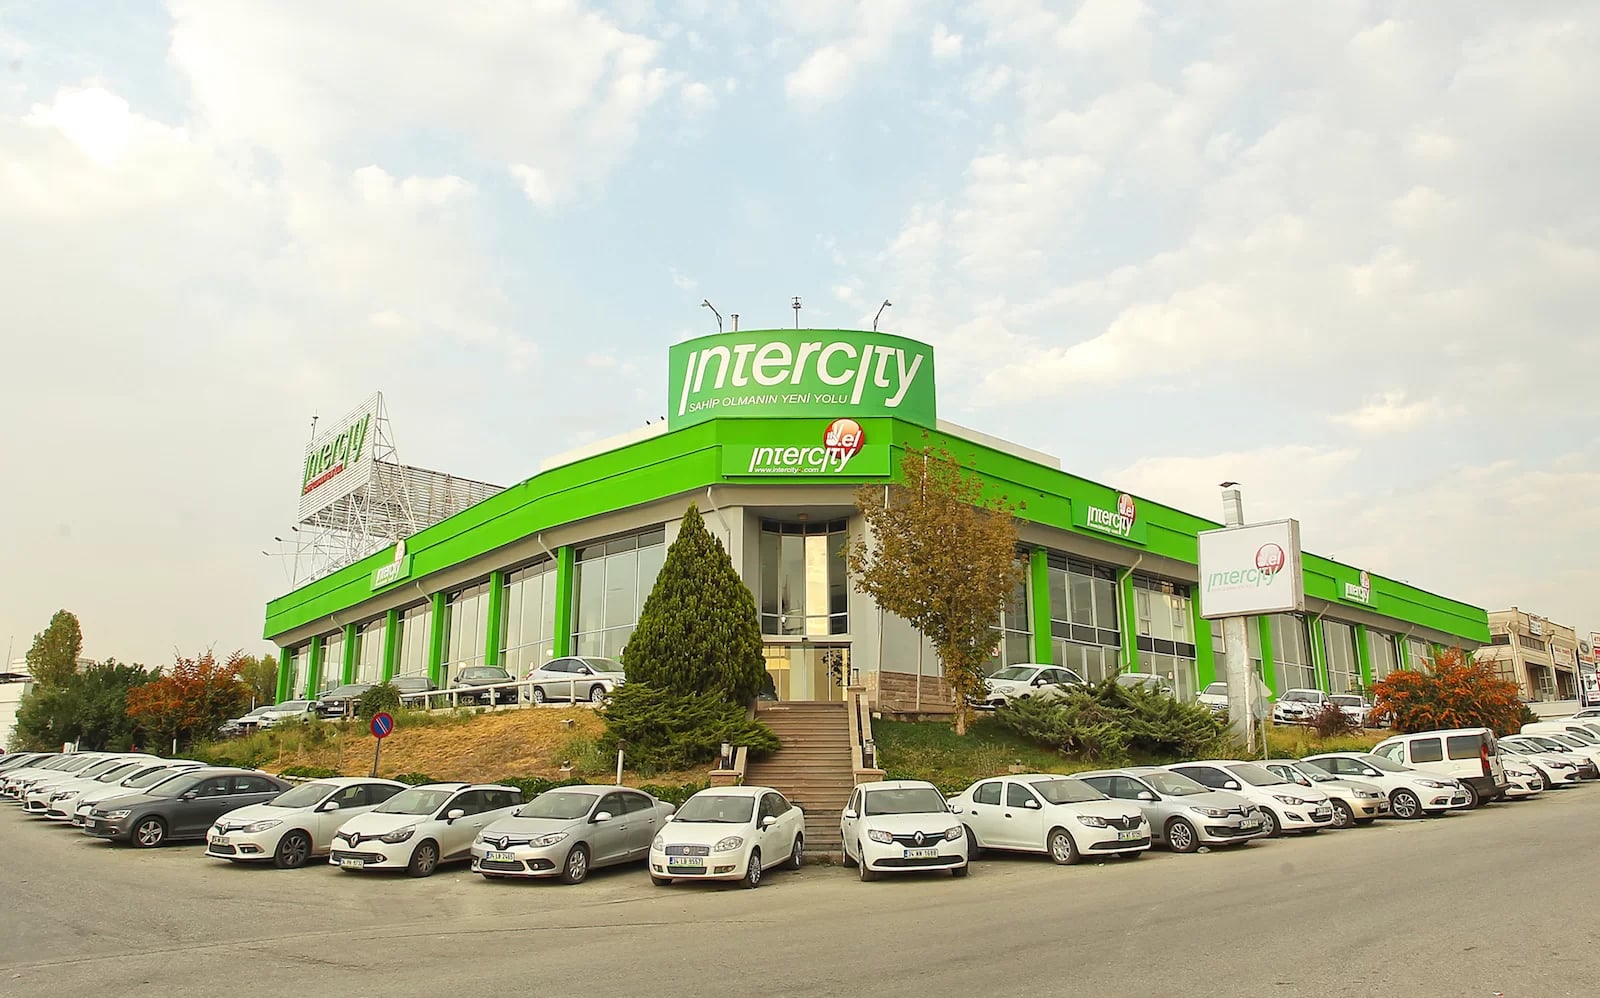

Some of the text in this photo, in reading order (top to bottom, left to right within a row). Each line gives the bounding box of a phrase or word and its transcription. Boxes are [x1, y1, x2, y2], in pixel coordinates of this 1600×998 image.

[688, 392, 848, 413] SAHİP OLMANIN YENİ YOLU
